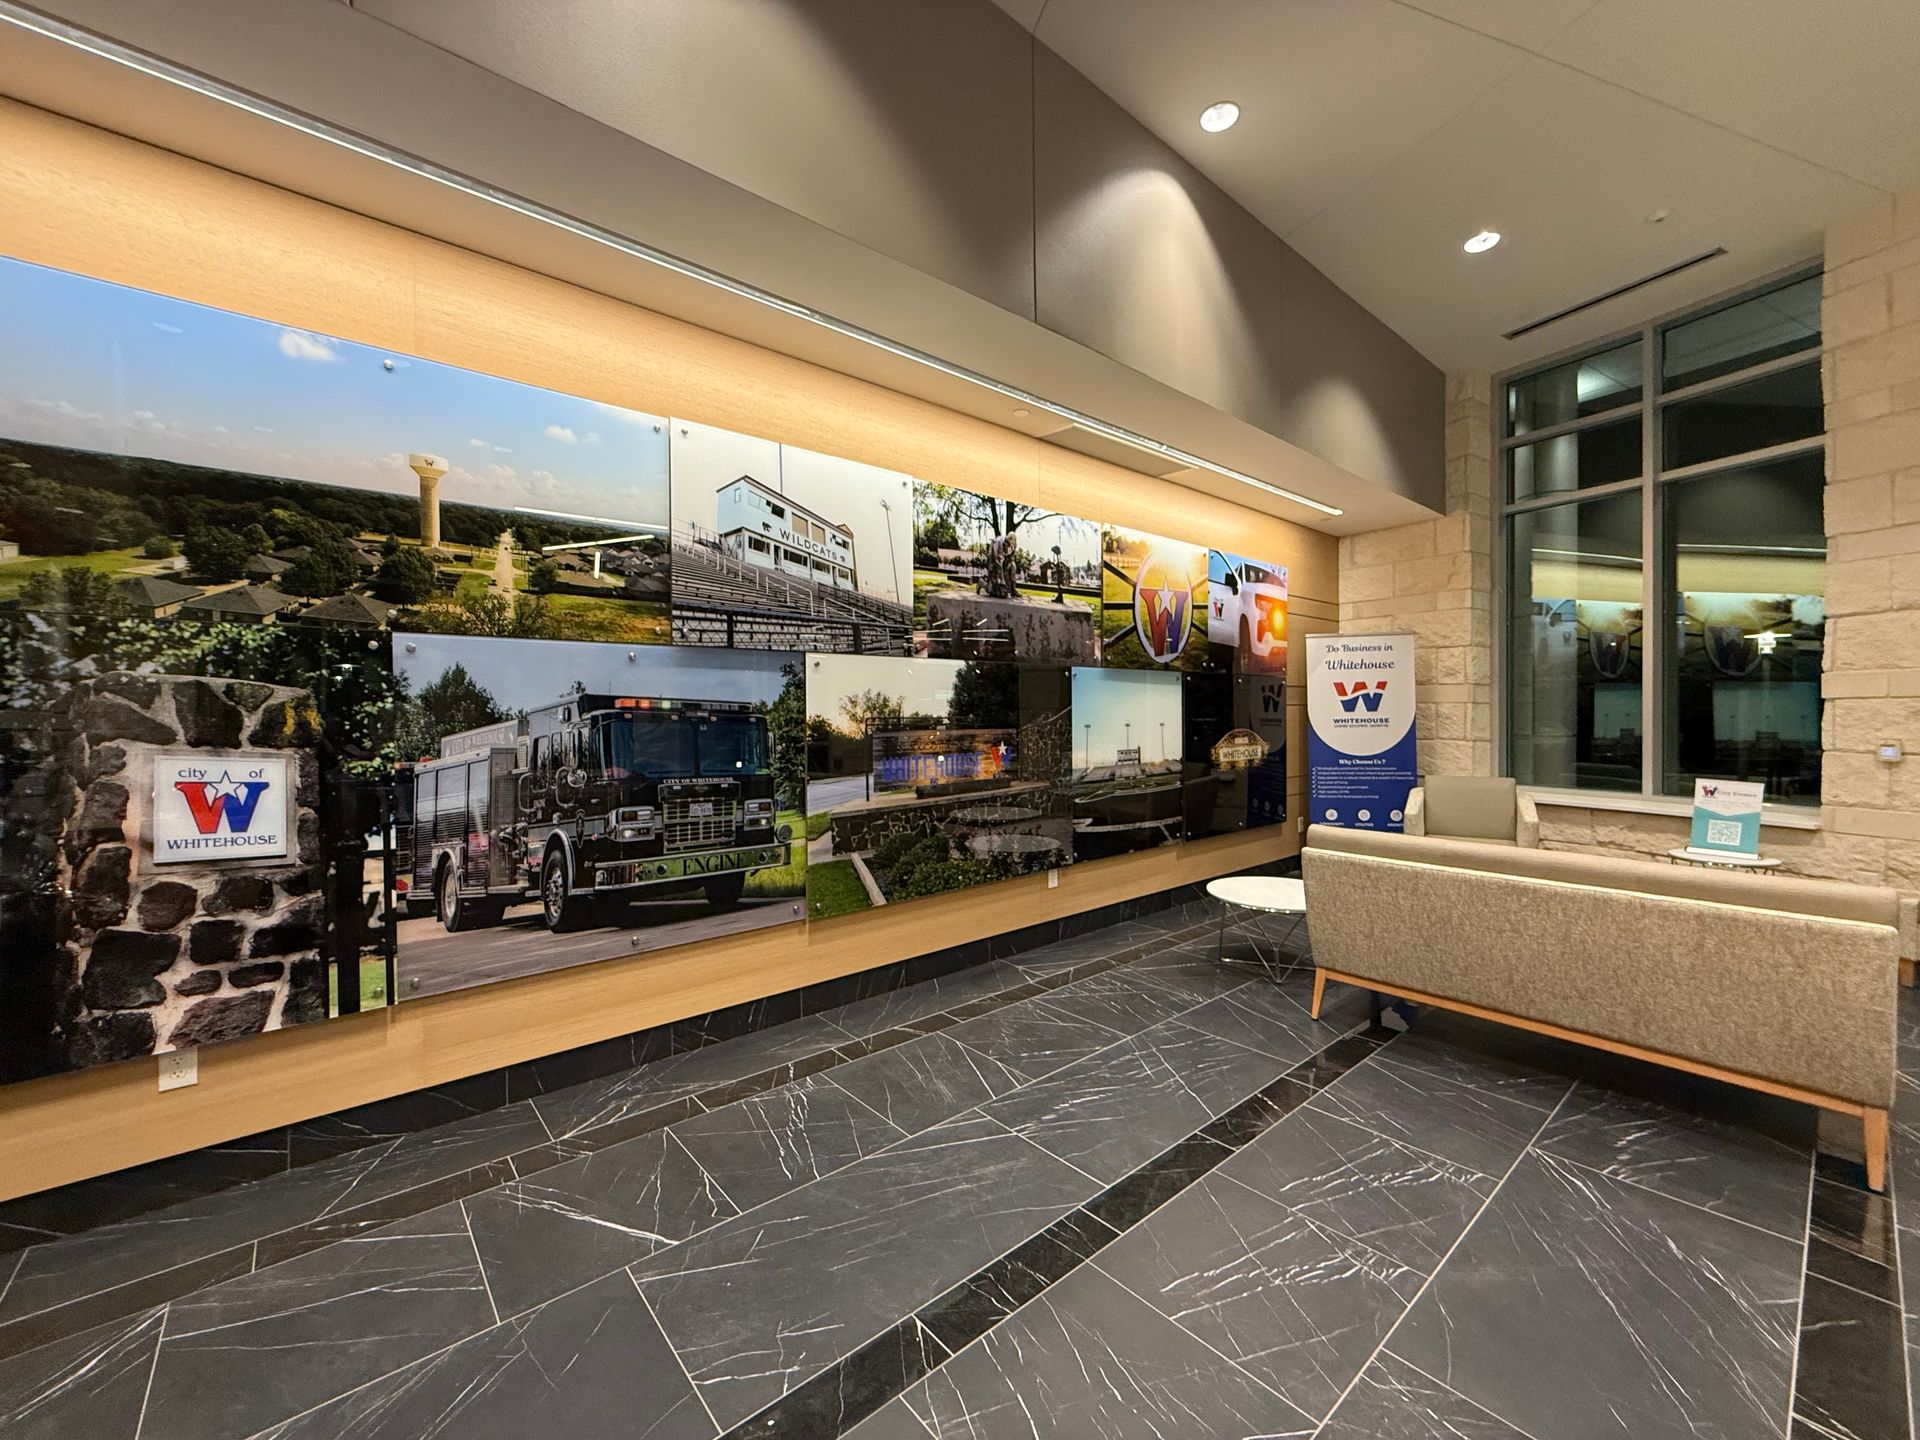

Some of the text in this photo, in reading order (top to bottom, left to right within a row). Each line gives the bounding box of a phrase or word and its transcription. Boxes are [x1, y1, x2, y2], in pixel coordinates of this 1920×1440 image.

[779, 528, 838, 560] WILDCATS
[1325, 642, 1394, 653] Do Business in
[1324, 658, 1395, 671] Whitehouse
[1333, 681, 1388, 713] W
[1221, 747, 1260, 760] WHITEHOUSE
[178, 767, 265, 780] city of
[881, 751, 983, 782] WHITEHOUSE
[174, 781, 270, 835] W
[167, 835, 278, 850] WHITEHOUSE
[683, 852, 745, 876] ENGINE
